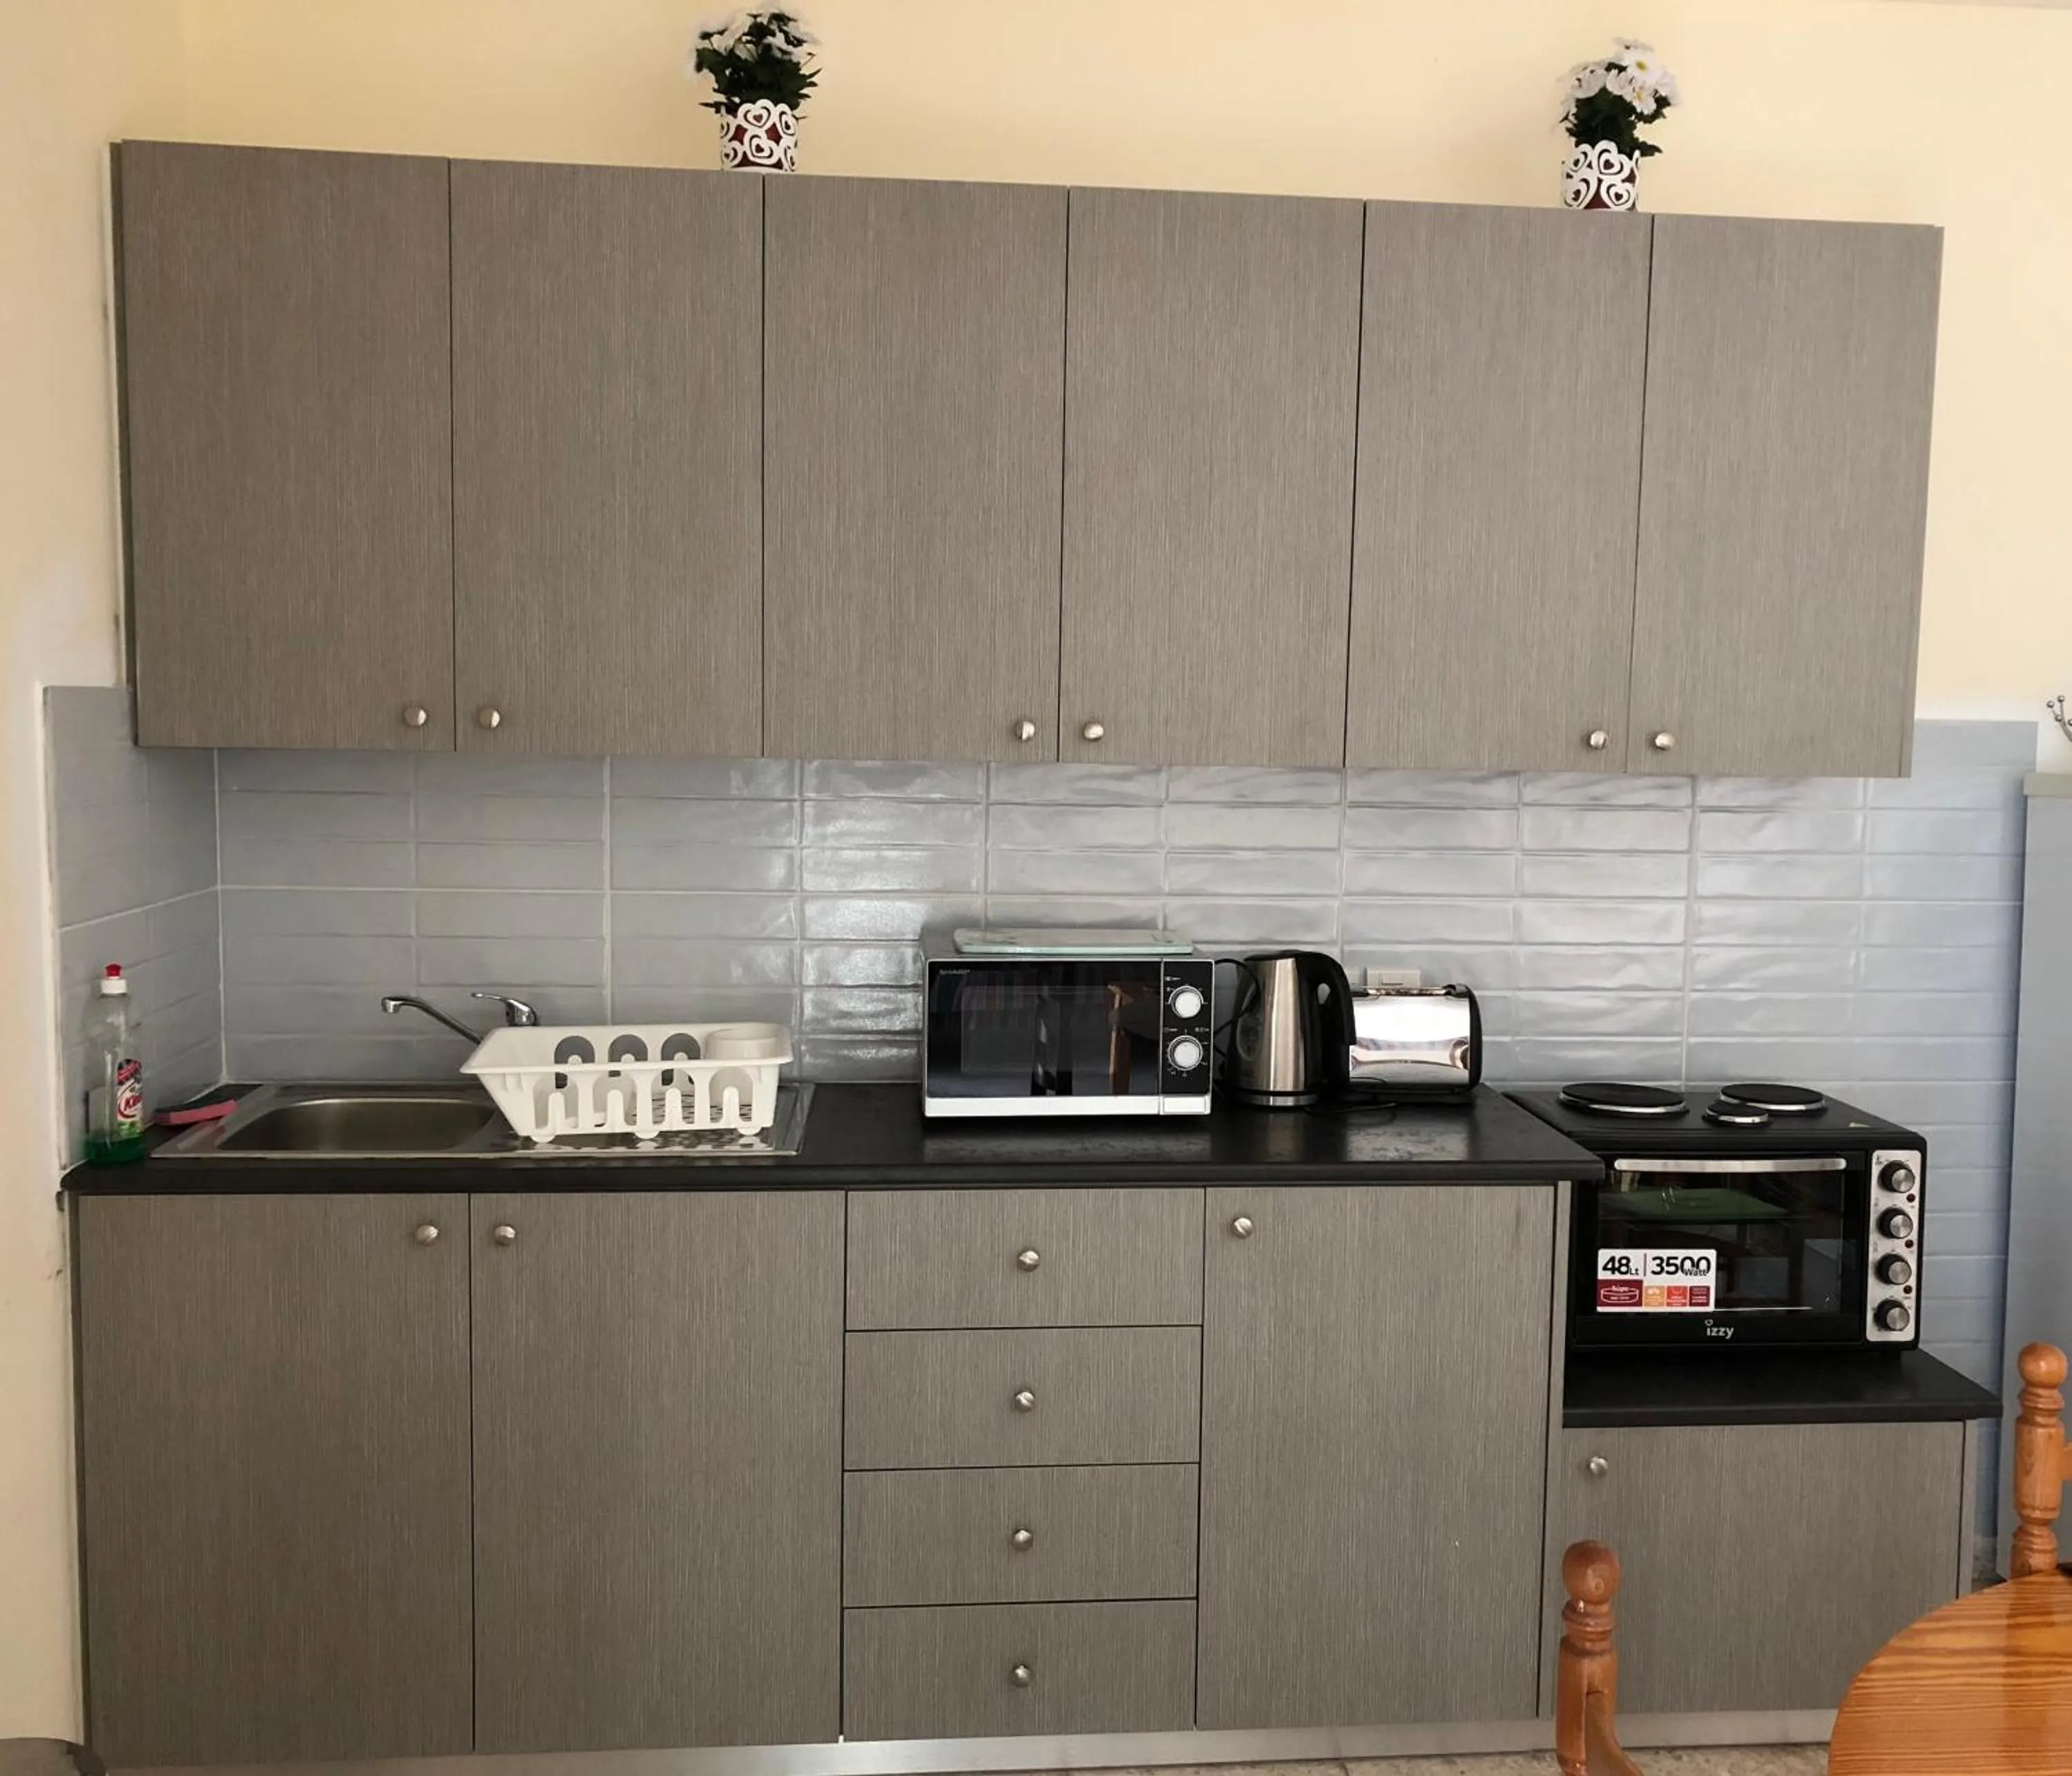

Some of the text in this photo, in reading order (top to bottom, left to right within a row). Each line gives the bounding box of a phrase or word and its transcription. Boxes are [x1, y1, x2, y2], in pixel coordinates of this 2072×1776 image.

[1602, 1255, 1631, 1275] 48
[1651, 1255, 1711, 1275] 3500
[1705, 1320, 1734, 1340] izzy
